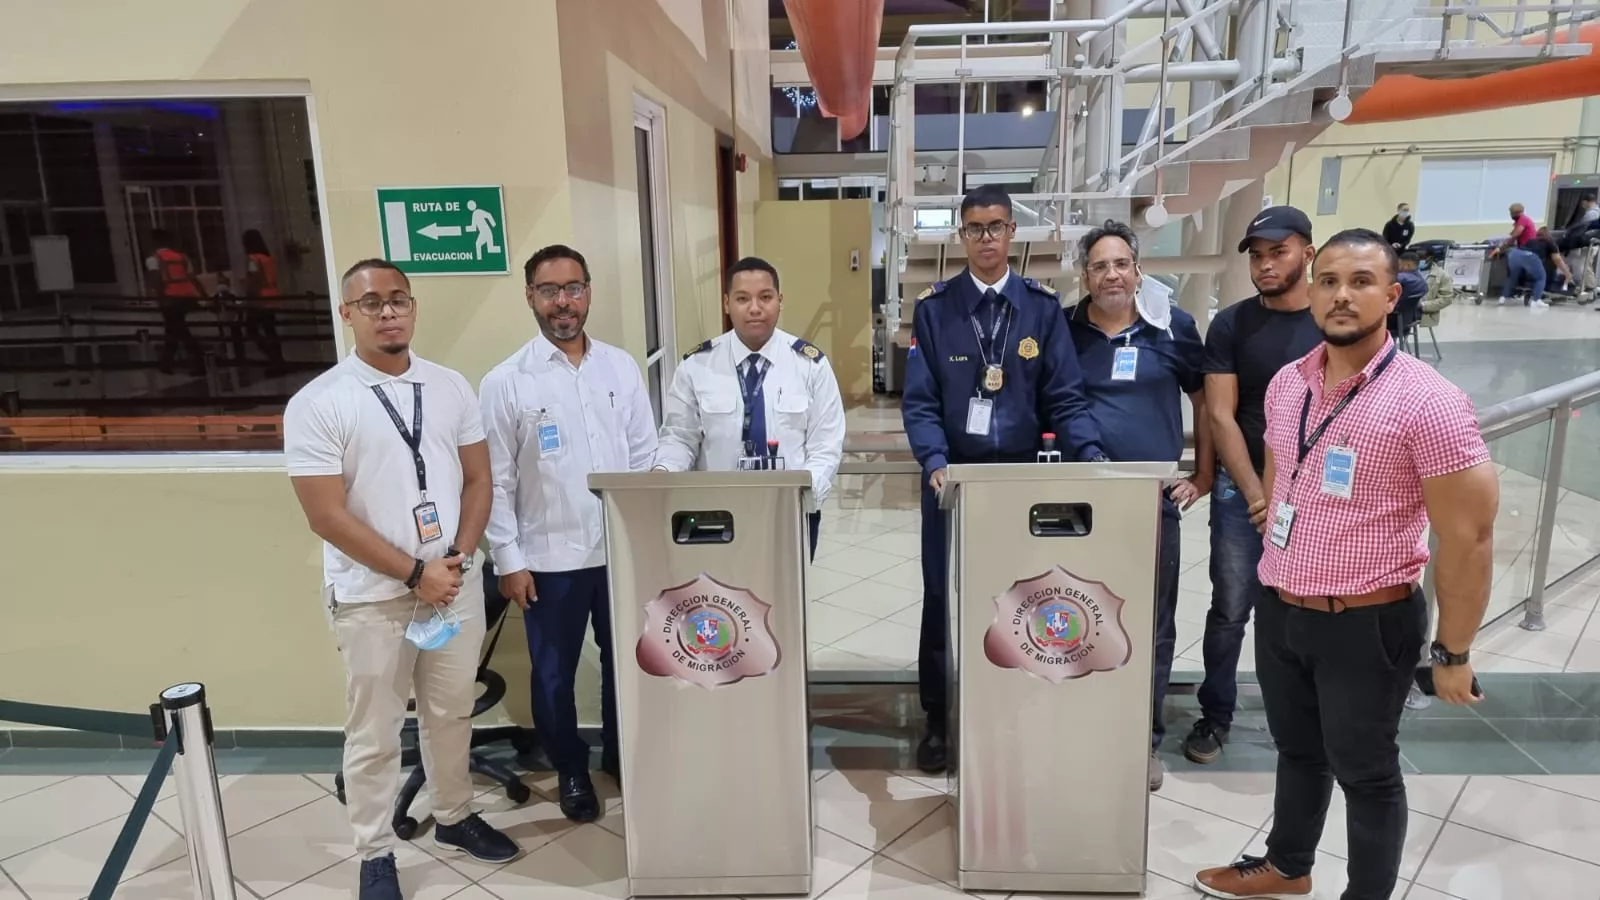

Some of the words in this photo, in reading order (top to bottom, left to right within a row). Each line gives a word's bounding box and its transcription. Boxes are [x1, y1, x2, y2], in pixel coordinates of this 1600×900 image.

[412, 202, 442, 212] RUTA
[445, 201, 461, 211] DE
[413, 252, 473, 261] EVACUACION
[663, 594, 709, 633] DIRECCION
[712, 595, 752, 632] GENERAL
[1012, 586, 1061, 625] DIRECCION
[1065, 587, 1104, 626] GENERAL
[672, 650, 686, 663] DE
[687, 649, 745, 672] MIGRACION
[1020, 642, 1032, 656] DE
[1034, 643, 1095, 665] MIGRACION
